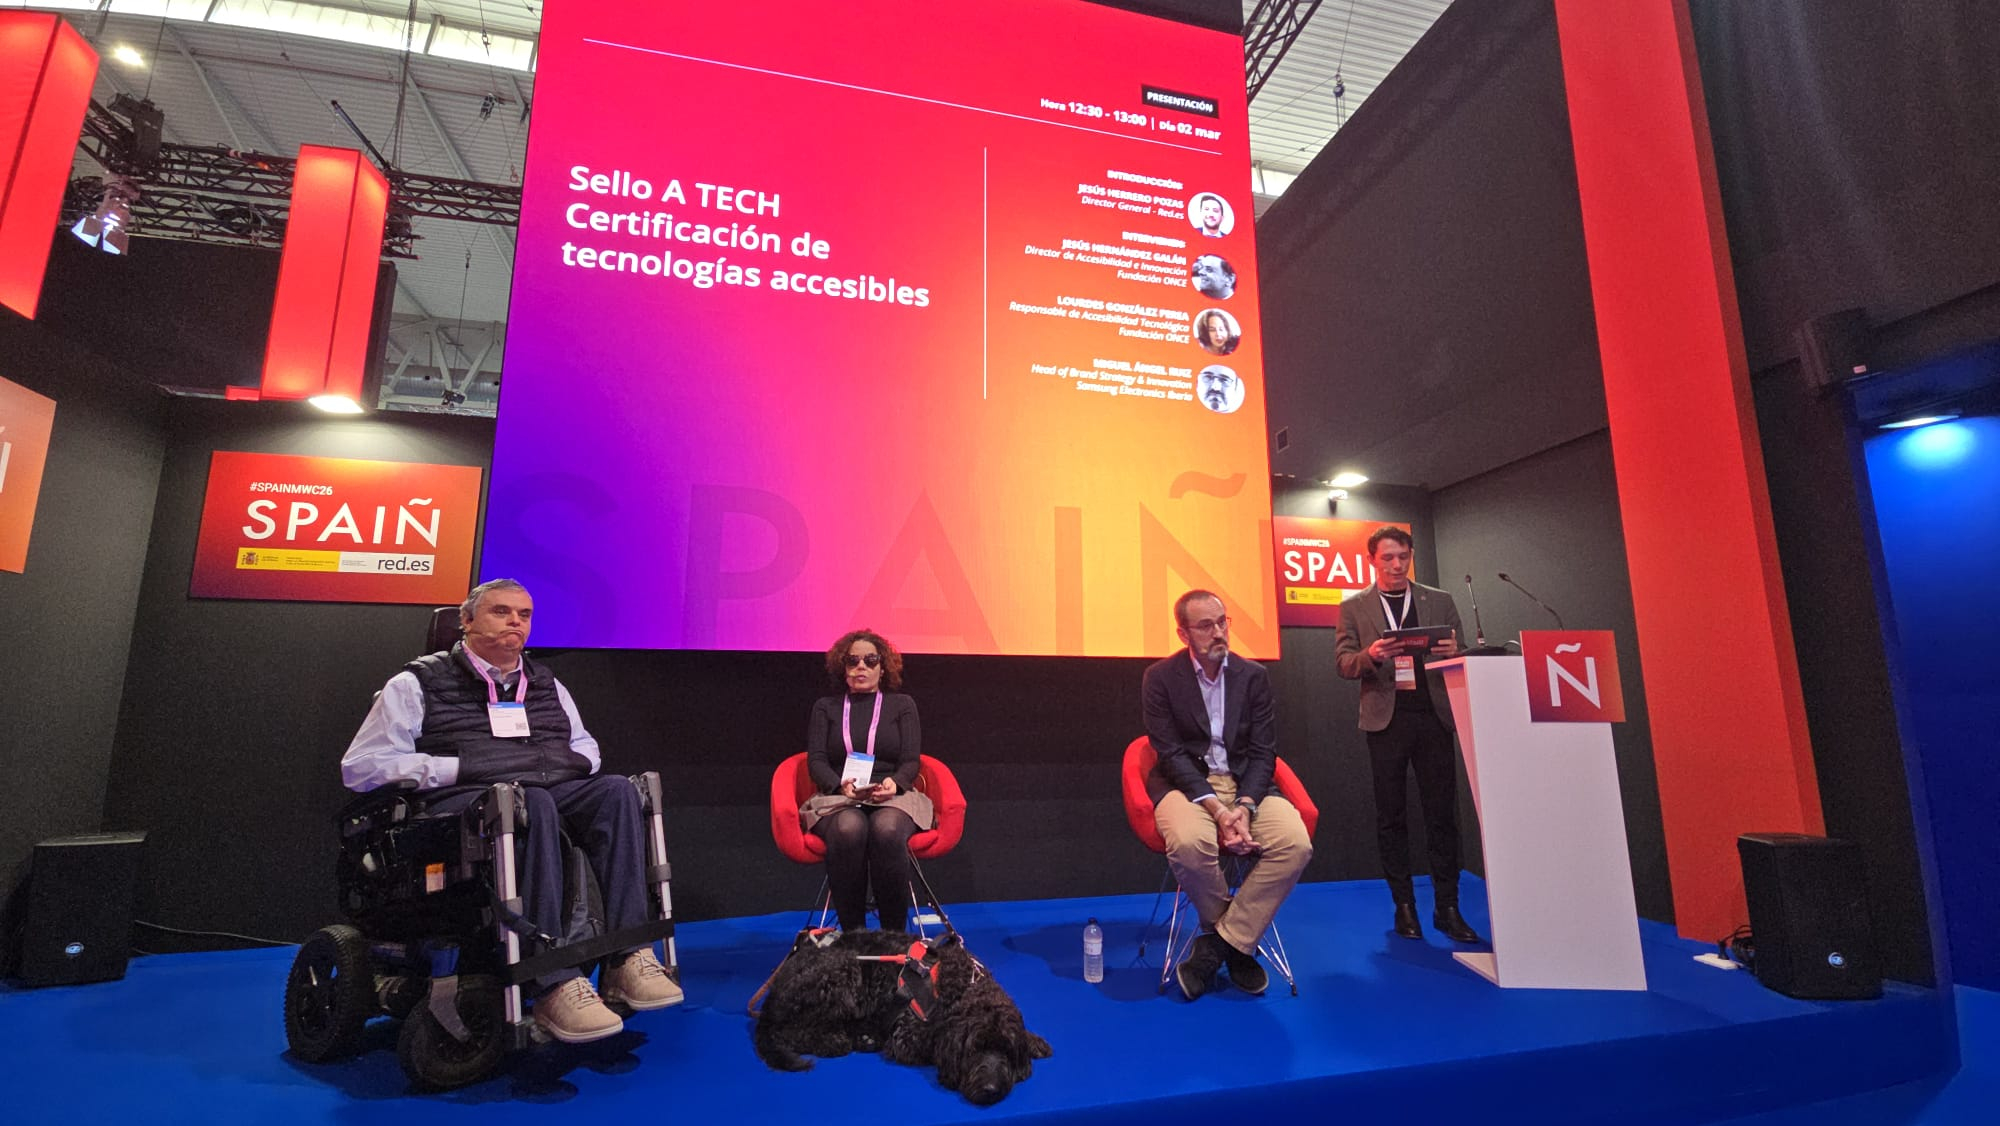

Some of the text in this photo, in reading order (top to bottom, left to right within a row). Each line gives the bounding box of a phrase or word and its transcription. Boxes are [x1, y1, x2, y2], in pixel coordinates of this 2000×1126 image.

[1147, 91, 1214, 113] PRESENTACIÓN
[1040, 98, 1066, 111] Hora
[1068, 101, 1102, 118] 12:30
[1113, 110, 1147, 126] 13:00
[1159, 120, 1176, 132] Día
[1177, 122, 1193, 135] 02
[1195, 127, 1221, 141] mar
[568, 165, 781, 218] Sello A TECH
[1077, 183, 1184, 209] JESÚS HERRERO POZAS
[1081, 195, 1116, 208] Director
[1118, 201, 1151, 215] General
[1157, 208, 1184, 219] Red.es
[565, 202, 831, 261] Certificación de
[1024, 244, 1187, 276] Director de Accesibilidad e Innovación
[1062, 238, 1187, 265] JESÚS HERNÁNDEZ GALÁN
[561, 241, 930, 308] tecnologías accesibles
[1117, 269, 1187, 287] Fundación ONCE
[1009, 301, 1190, 333] Responsable de Accesibilidad Tecnológica
[1057, 295, 1104, 310] LOURDES
[1105, 301, 1158, 317] GONZÁLEZ
[1118, 326, 1190, 344] Fundación ONCE
[1031, 363, 1193, 390] Head of Brand Strategy & Innovation
[1076, 380, 1193, 401] Samsung Electronics Iberia
[249, 481, 333, 496] #SPAINMWC26
[241, 497, 441, 548] SPAIÑ
[377, 556, 430, 572] red.es
[1545, 642, 1601, 709] Ñ
